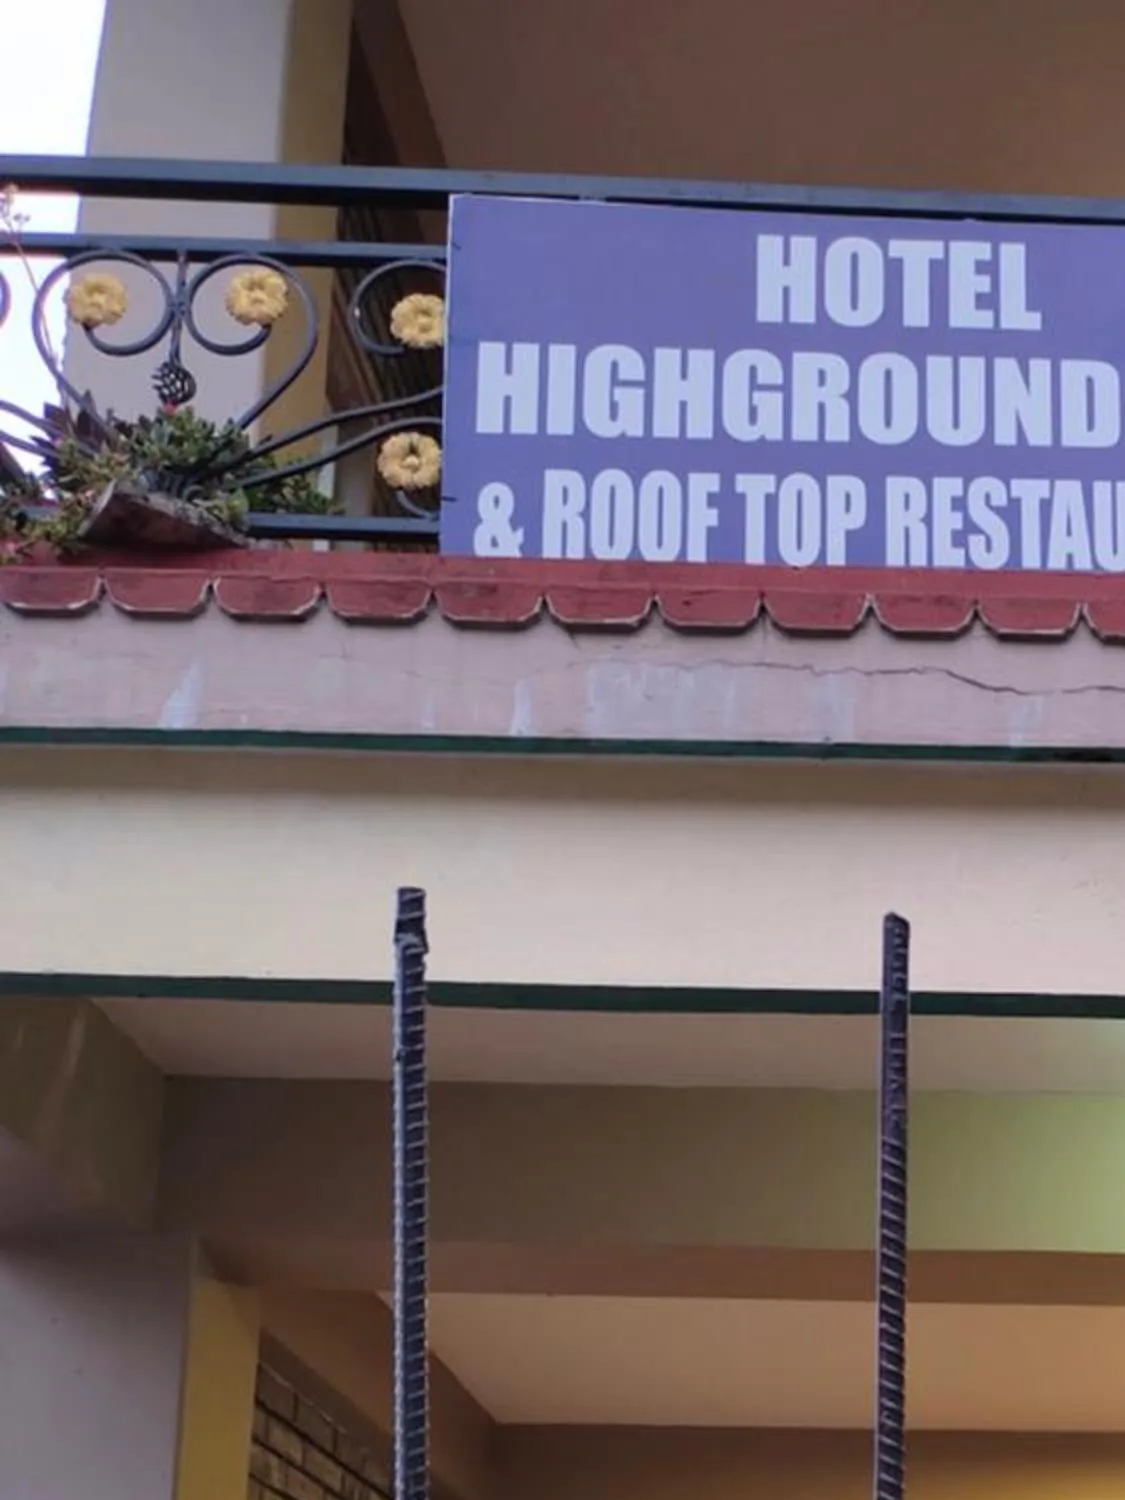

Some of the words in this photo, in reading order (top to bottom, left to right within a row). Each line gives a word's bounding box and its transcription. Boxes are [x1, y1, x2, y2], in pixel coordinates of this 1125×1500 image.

[756, 234, 1042, 331] HOTEL
[475, 341, 1121, 448] HIGHGROUND
[473, 482, 524, 558] &
[542, 468, 720, 563] ROOF
[735, 472, 867, 567] TOP
